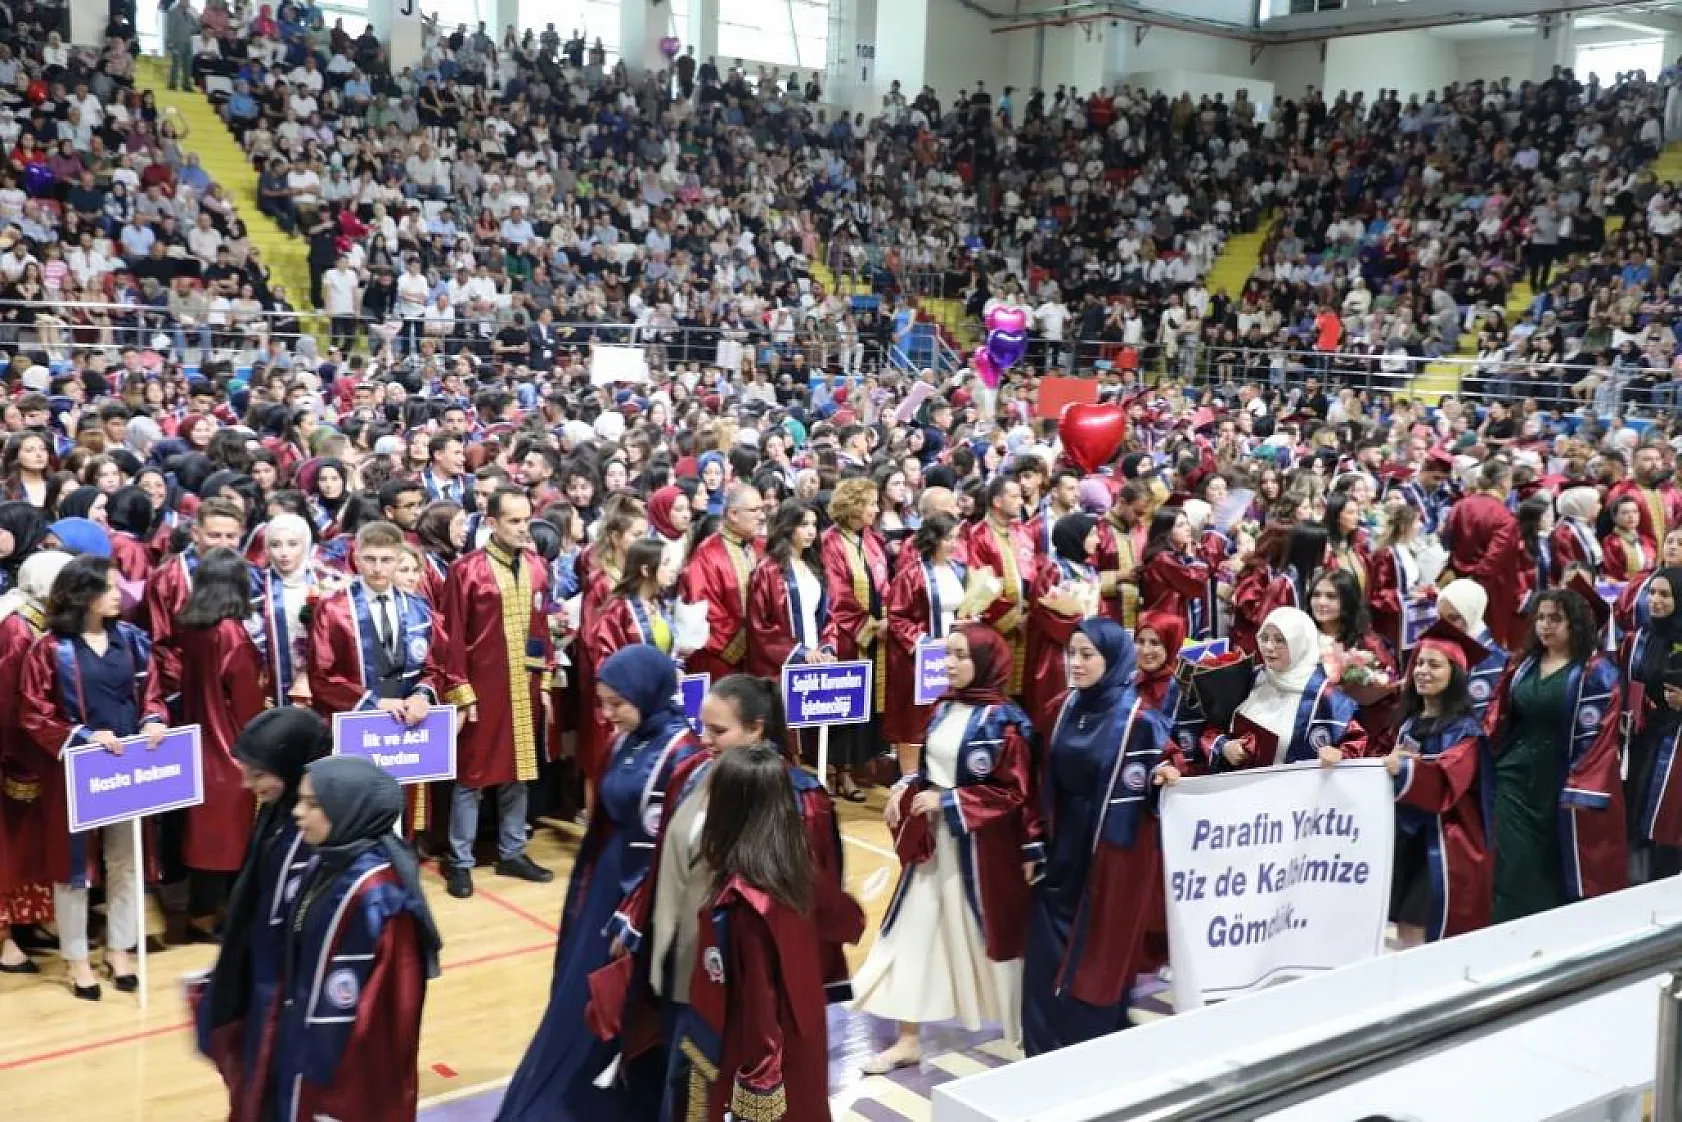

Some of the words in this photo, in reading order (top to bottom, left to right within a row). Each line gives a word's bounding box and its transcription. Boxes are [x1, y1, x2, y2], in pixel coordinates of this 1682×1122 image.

[362, 727, 382, 748] İlk
[382, 734, 401, 746] ve
[89, 772, 132, 793] Hasta
[1191, 812, 1284, 851] Parafin
[1215, 865, 1247, 896] de
